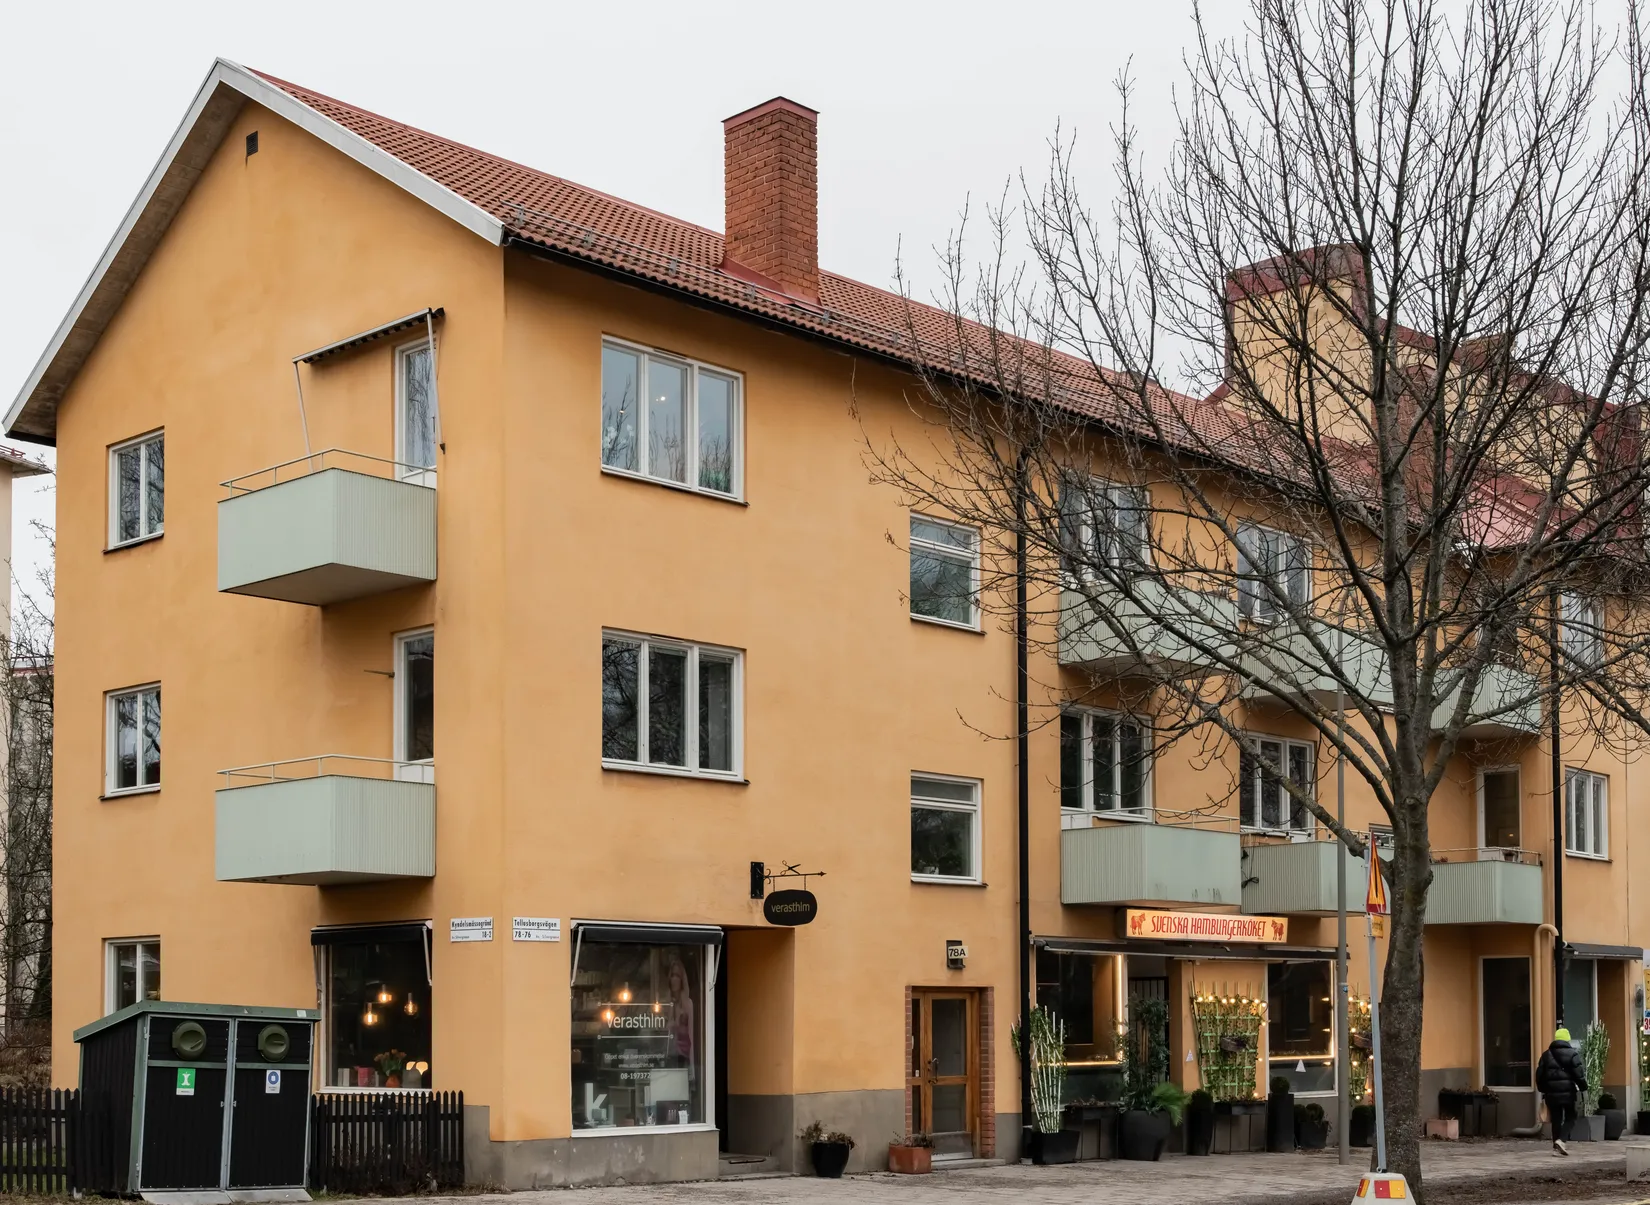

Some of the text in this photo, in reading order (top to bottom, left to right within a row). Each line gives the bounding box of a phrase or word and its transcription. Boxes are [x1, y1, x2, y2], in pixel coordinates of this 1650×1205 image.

[771, 901, 810, 913] verasthlm
[1151, 915, 1267, 940] SVENSKA HAMBURGERKÖKET
[514, 931, 531, 939] 78-76
[948, 948, 966, 957] 78A
[607, 1013, 666, 1029] verasthlm
